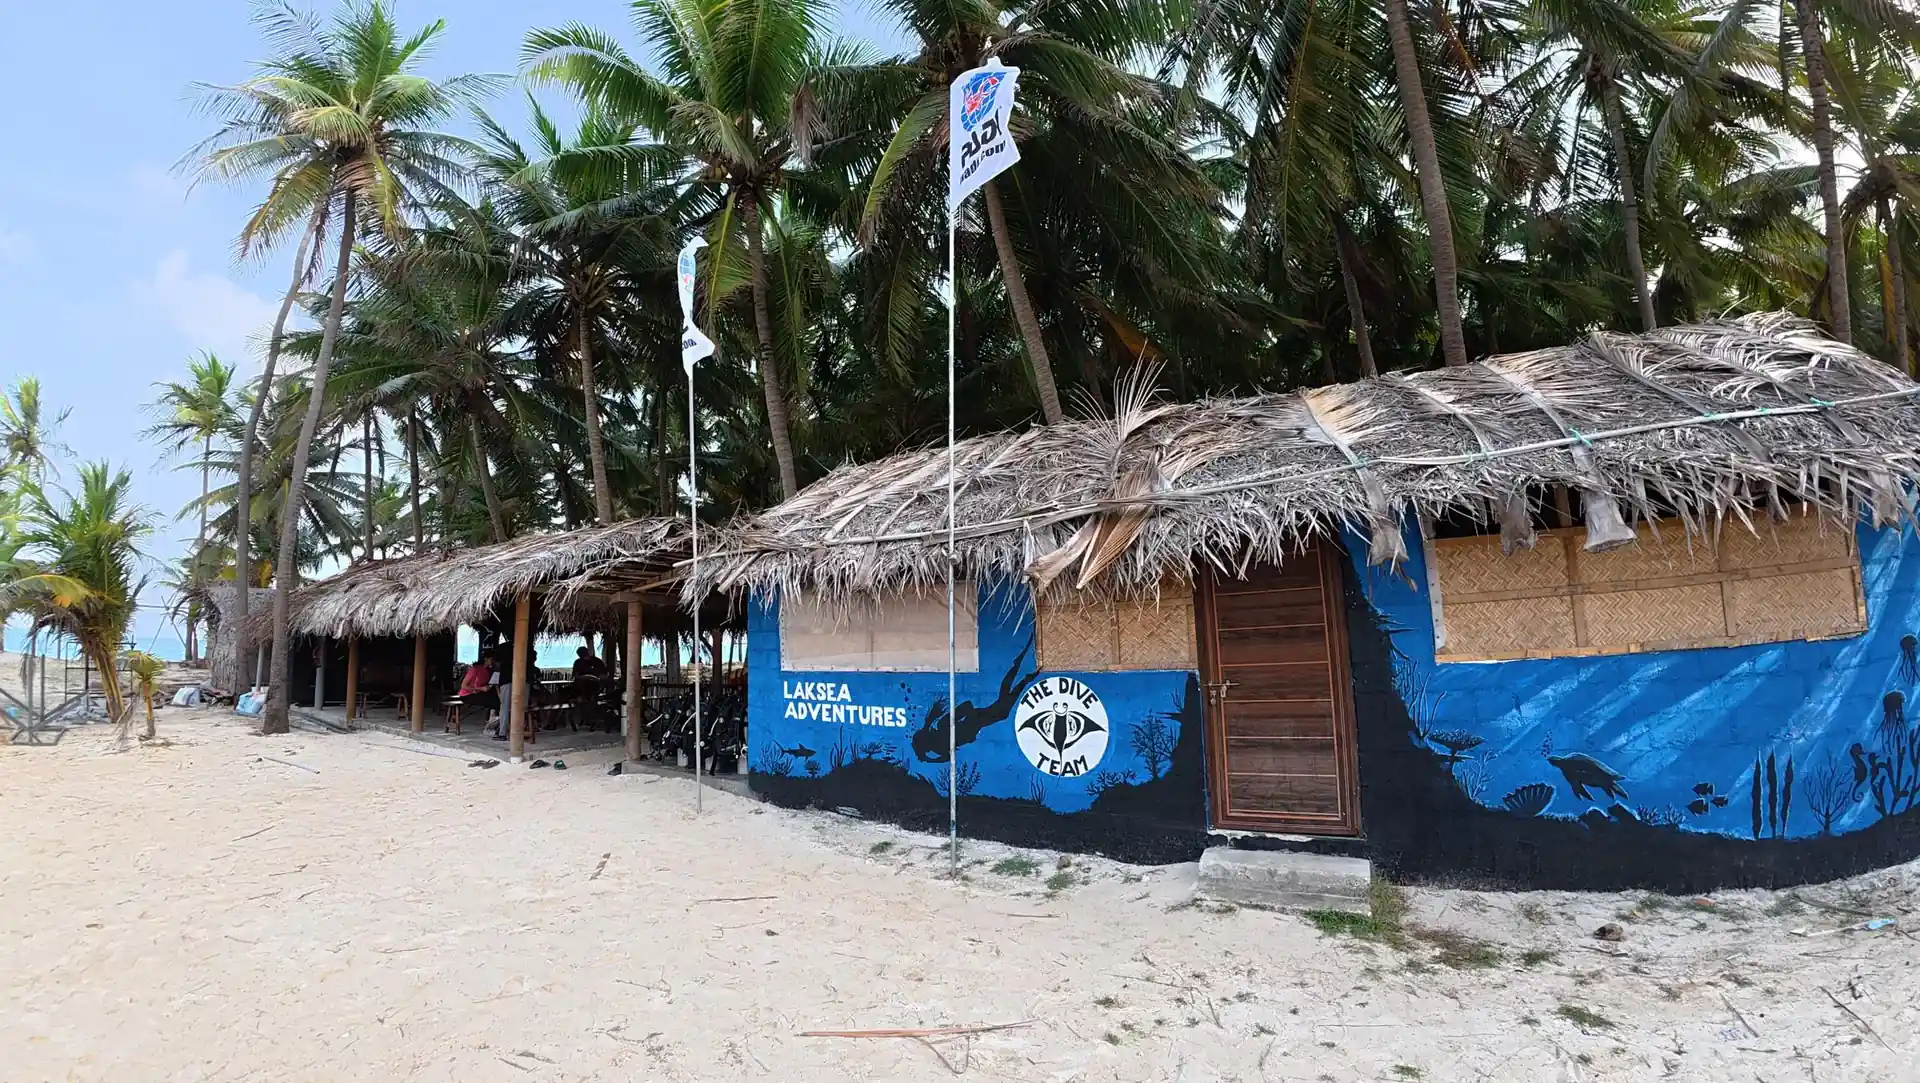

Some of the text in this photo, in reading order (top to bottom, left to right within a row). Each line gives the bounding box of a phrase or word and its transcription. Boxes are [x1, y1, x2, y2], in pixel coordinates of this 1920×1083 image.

[783, 680, 852, 702] LAKSEA
[1020, 677, 1098, 709] THE DIVE
[784, 701, 907, 727] ADVENTURES
[1036, 752, 1088, 776] TEAM
